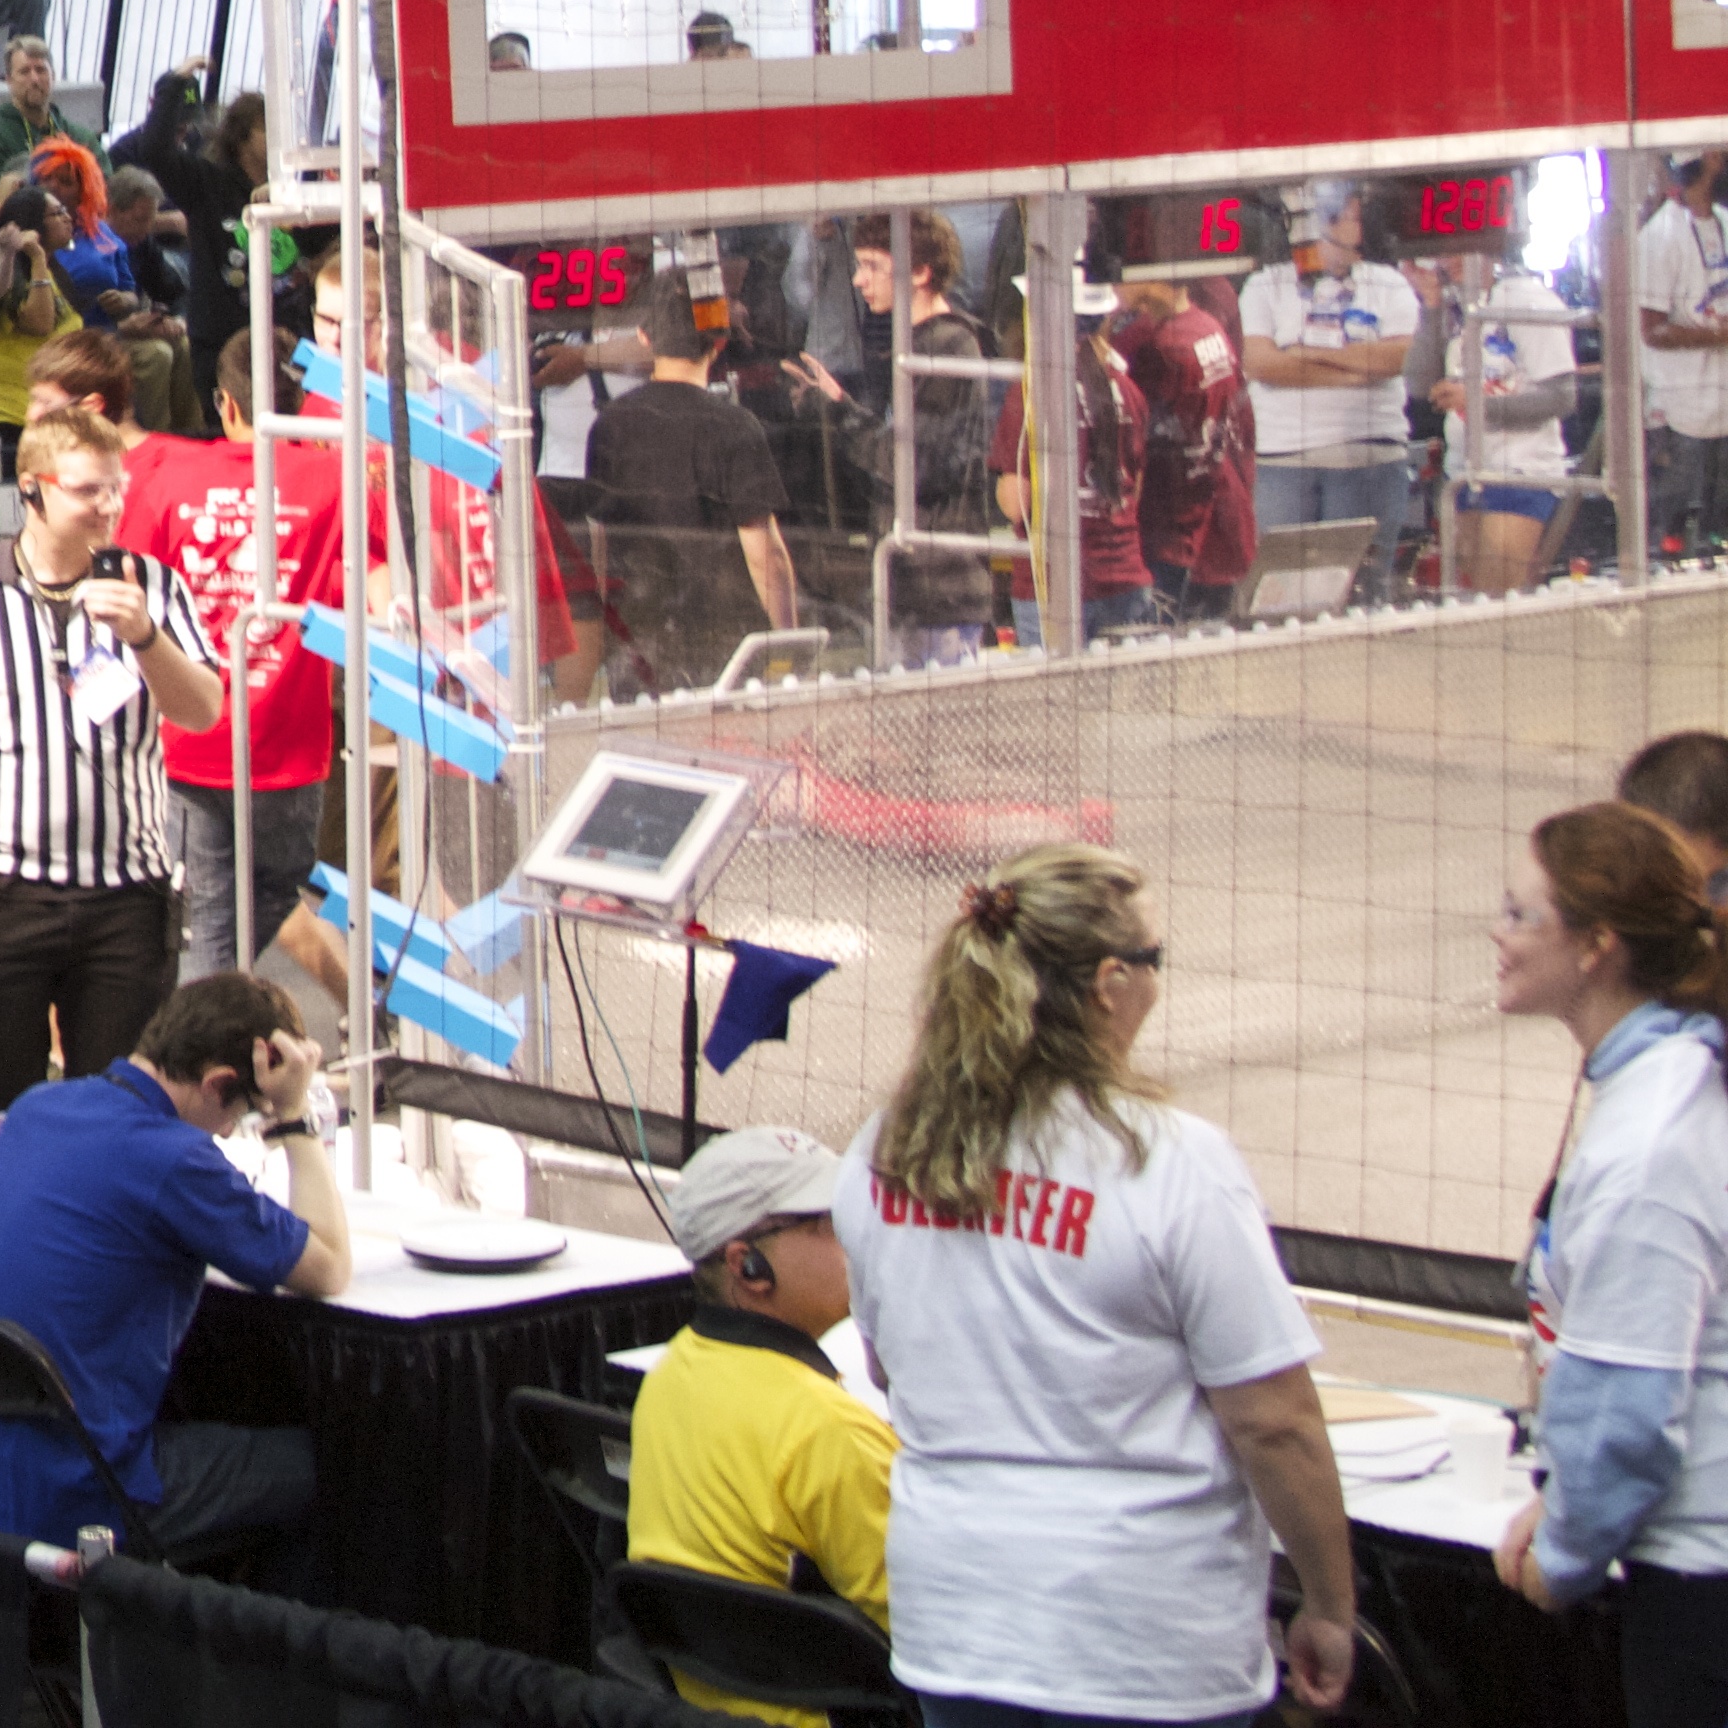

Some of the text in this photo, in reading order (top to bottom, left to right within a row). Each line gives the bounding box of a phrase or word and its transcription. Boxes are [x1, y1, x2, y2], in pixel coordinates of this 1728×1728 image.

[1199, 197, 1242, 254] 15
[1420, 175, 1516, 235] 1280
[530, 245, 626, 311] 295
[869, 1167, 1096, 1260] OTEER
